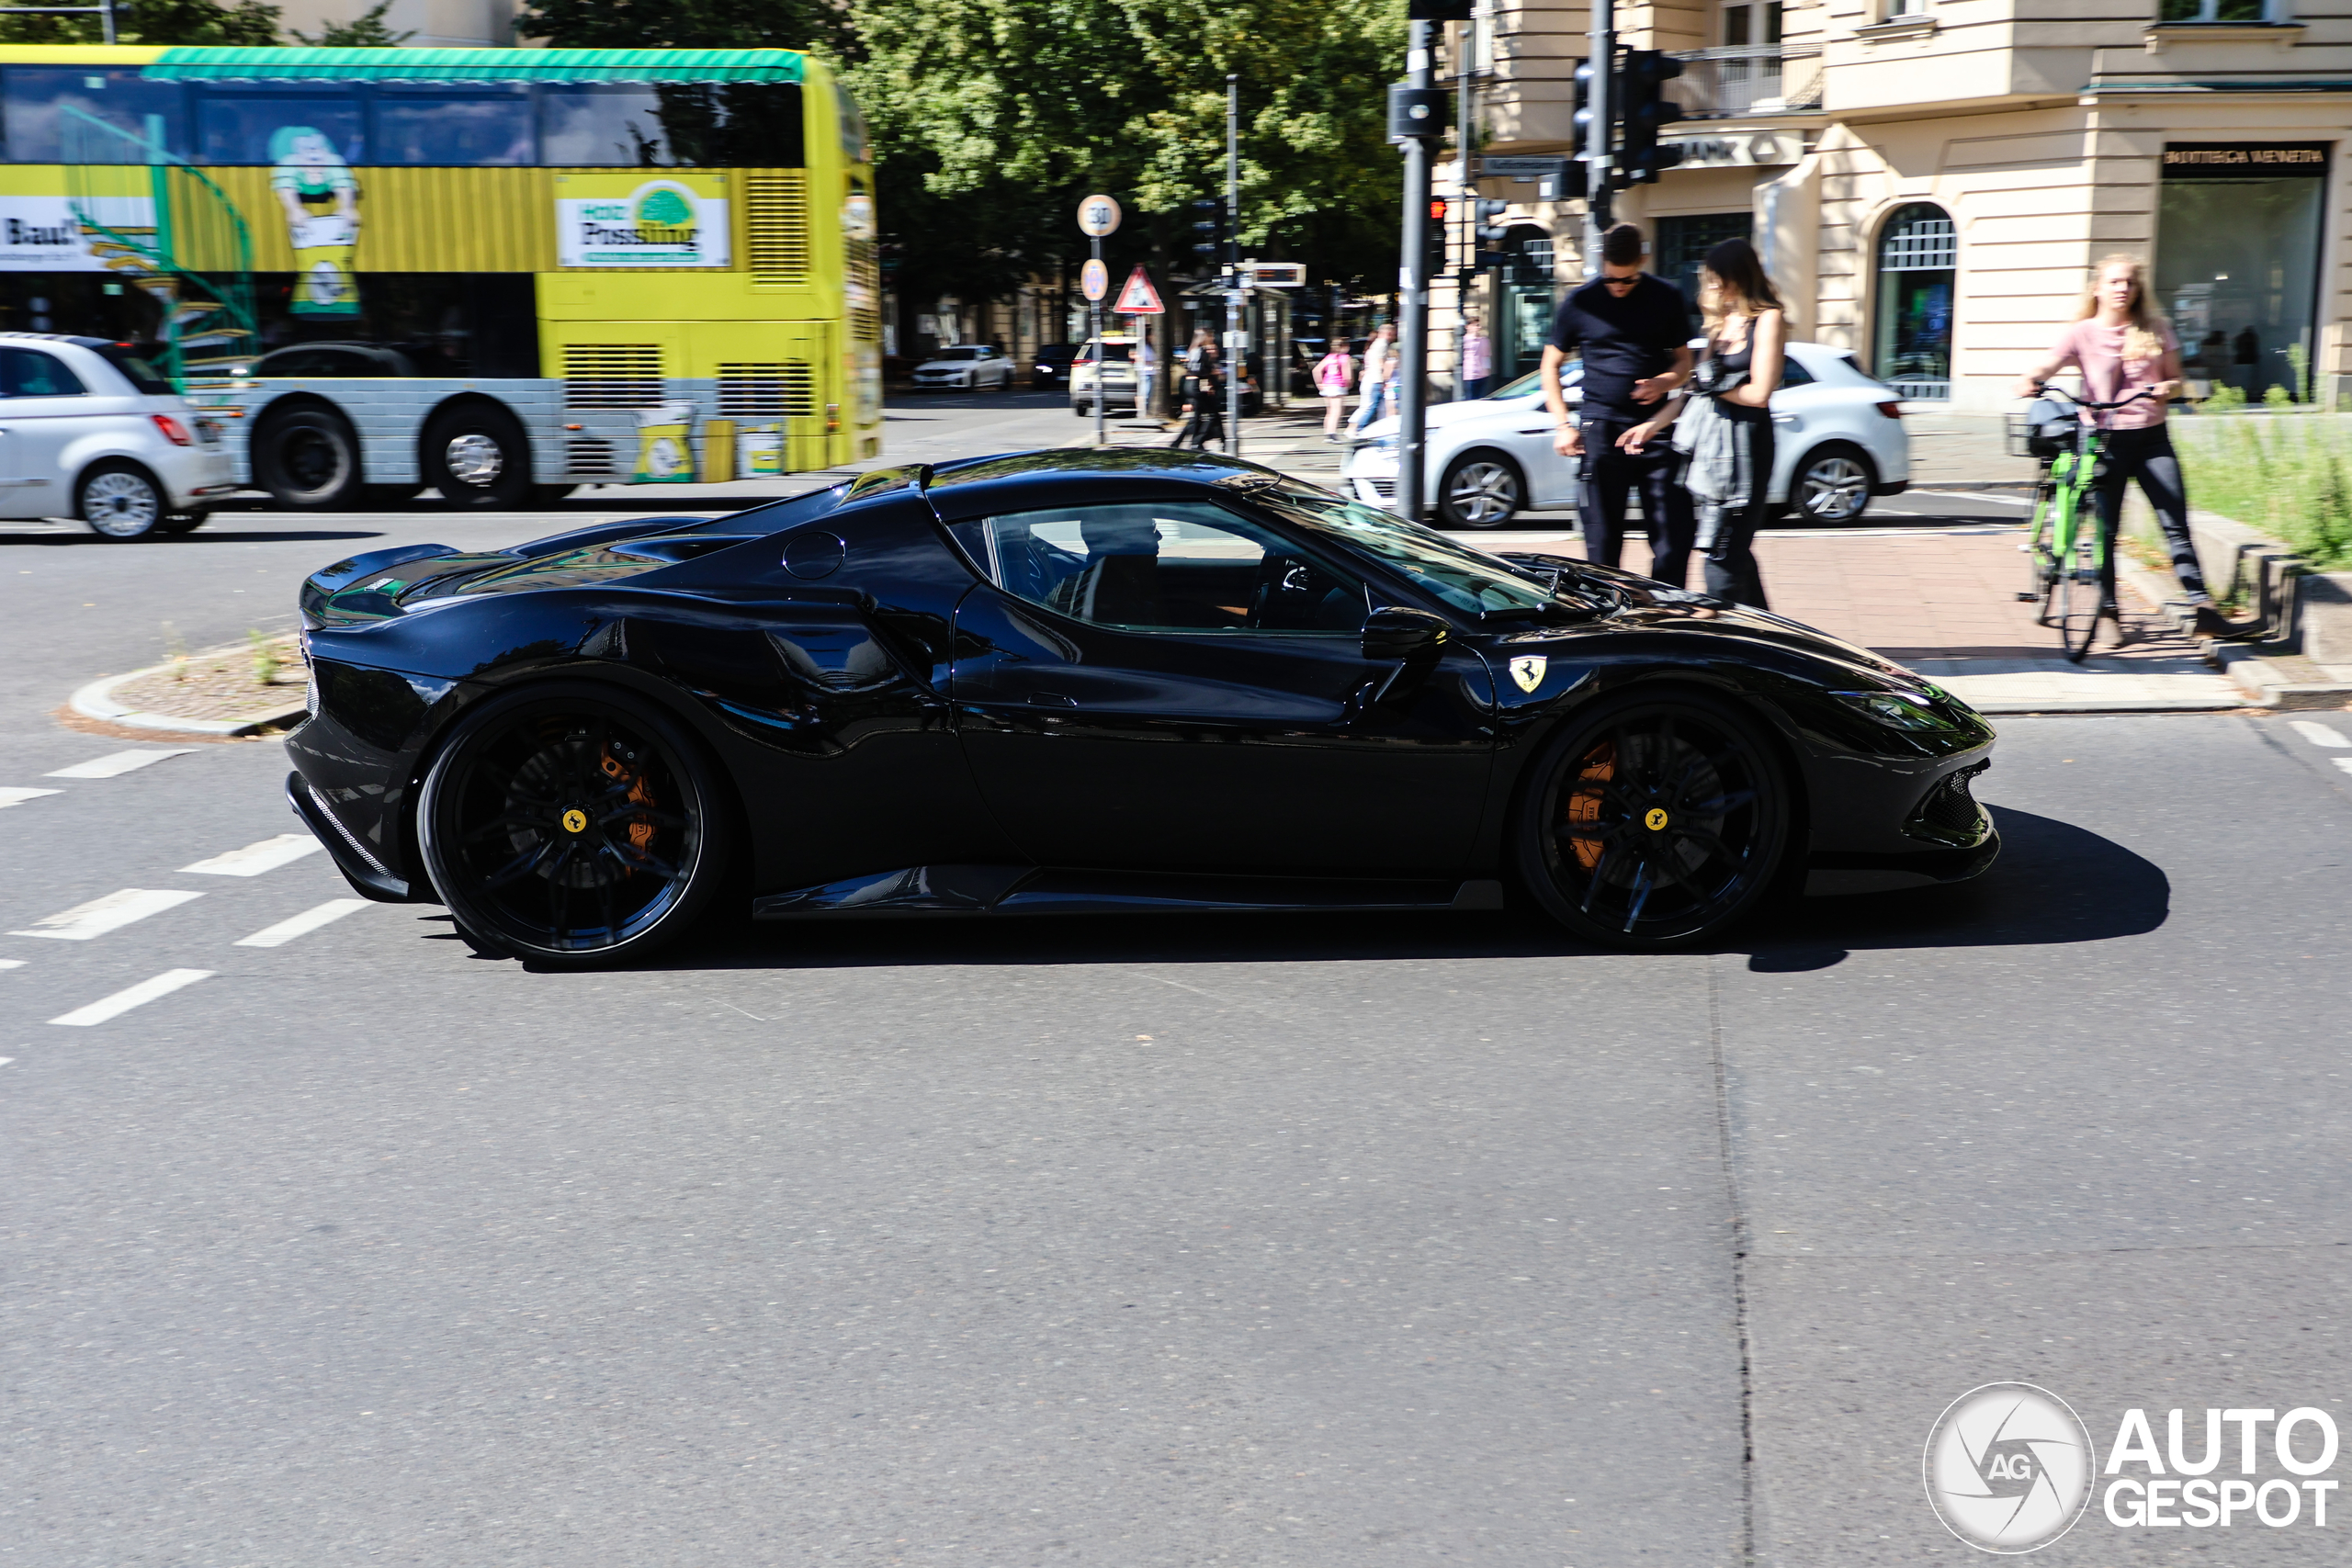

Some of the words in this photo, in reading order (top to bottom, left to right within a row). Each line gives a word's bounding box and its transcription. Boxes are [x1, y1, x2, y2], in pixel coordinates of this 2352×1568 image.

[2164, 151, 2249, 164] BOTTEGA
[2250, 150, 2324, 164] VENETA
[1085, 207, 1112, 224] 30
[580, 222, 702, 252] Possling
